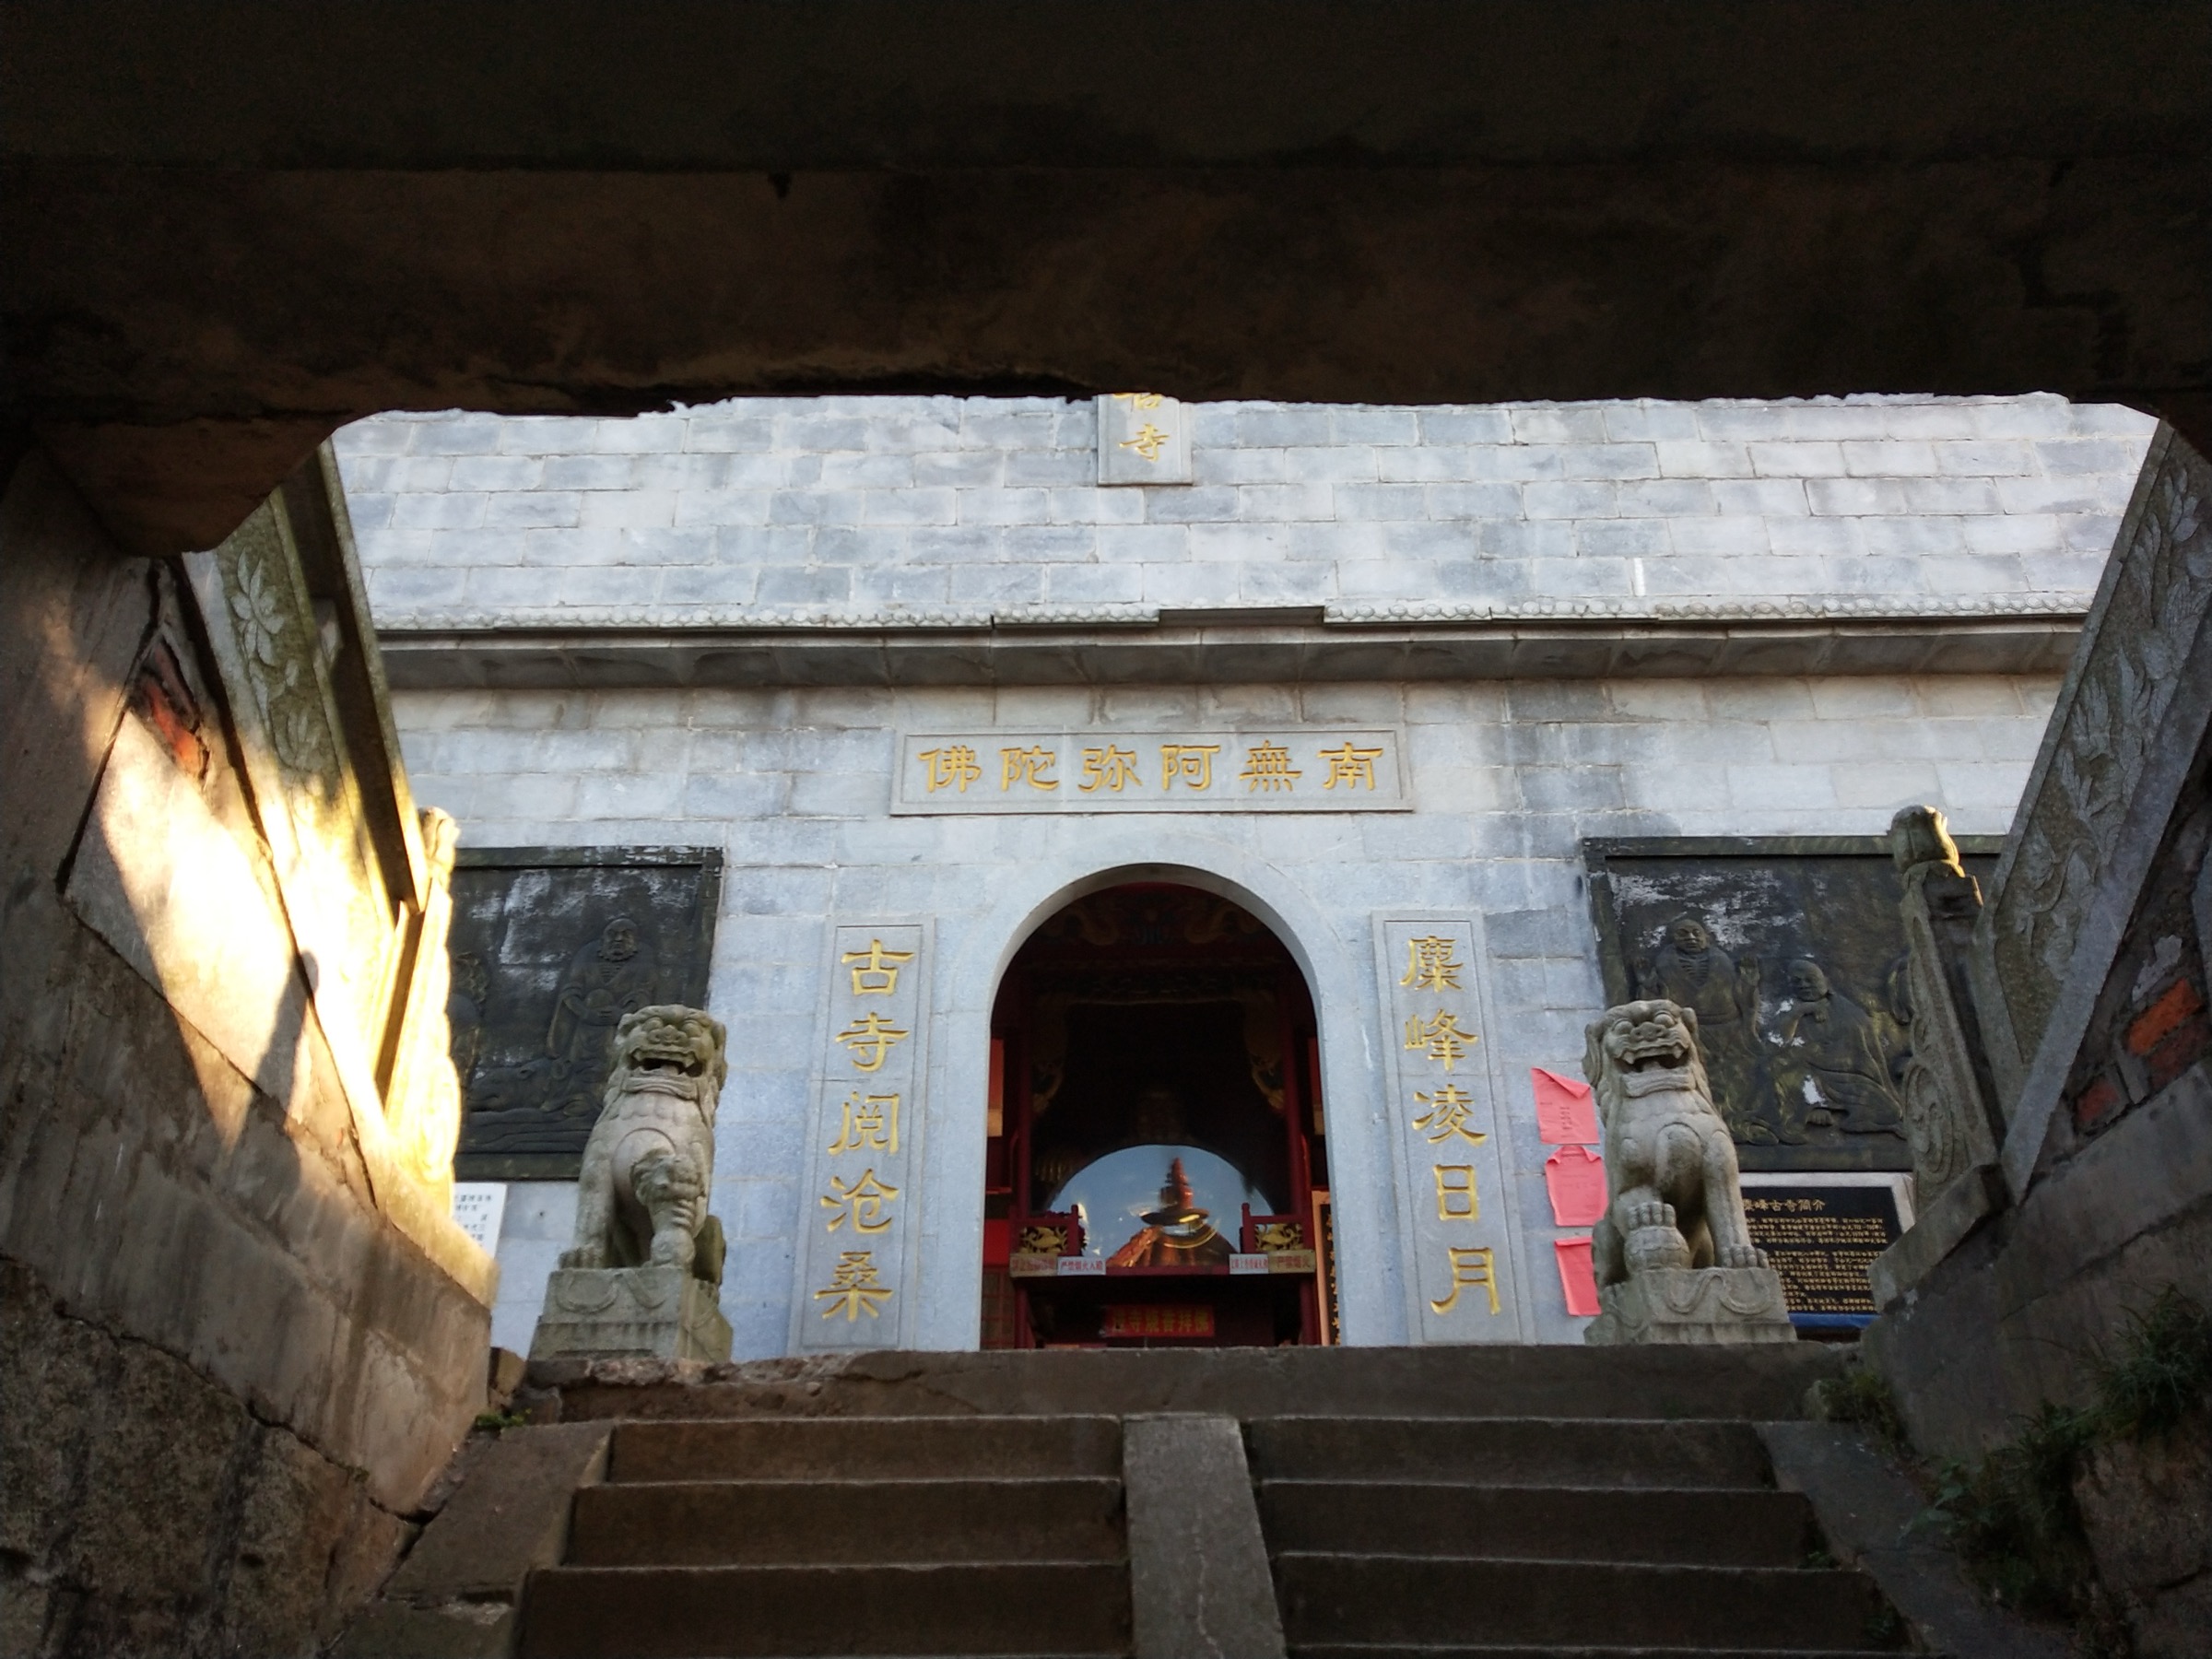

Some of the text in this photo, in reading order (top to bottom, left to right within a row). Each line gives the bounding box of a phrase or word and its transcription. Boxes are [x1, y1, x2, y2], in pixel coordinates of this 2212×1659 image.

[813, 938, 915, 1324] 古寺阅沧桑
